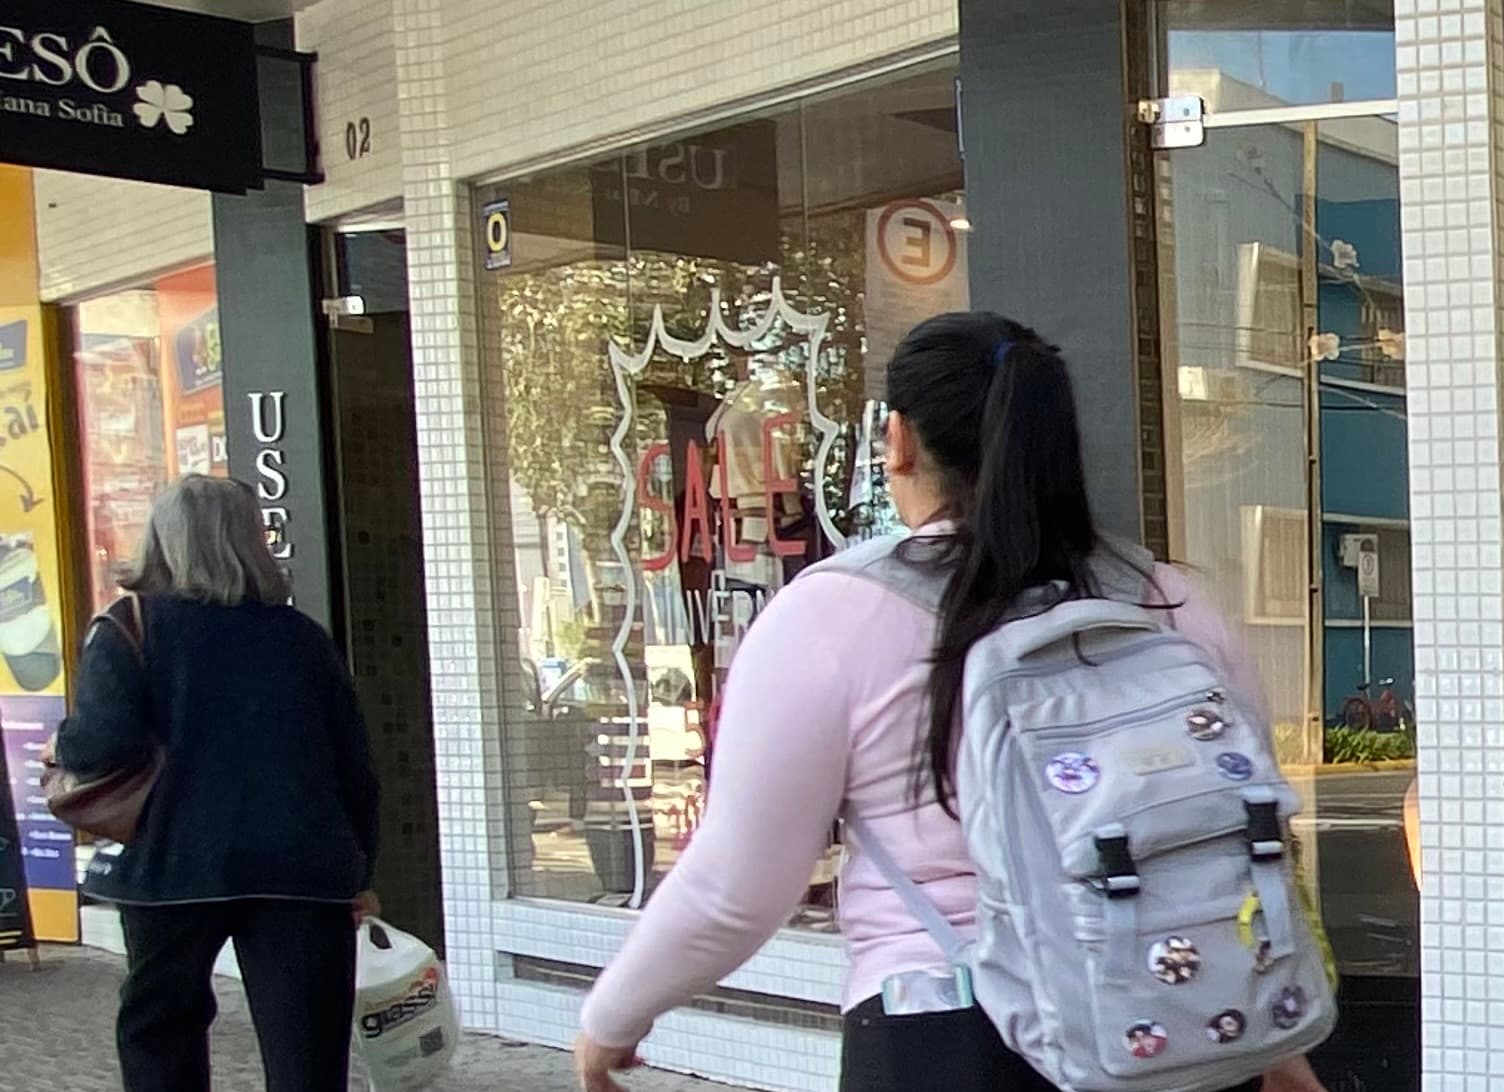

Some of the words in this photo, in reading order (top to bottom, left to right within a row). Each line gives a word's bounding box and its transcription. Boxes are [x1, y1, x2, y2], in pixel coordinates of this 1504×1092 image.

[58, 99, 125, 128] Sofia
[346, 117, 370, 161] 02
[636, 411, 808, 571] SALE
